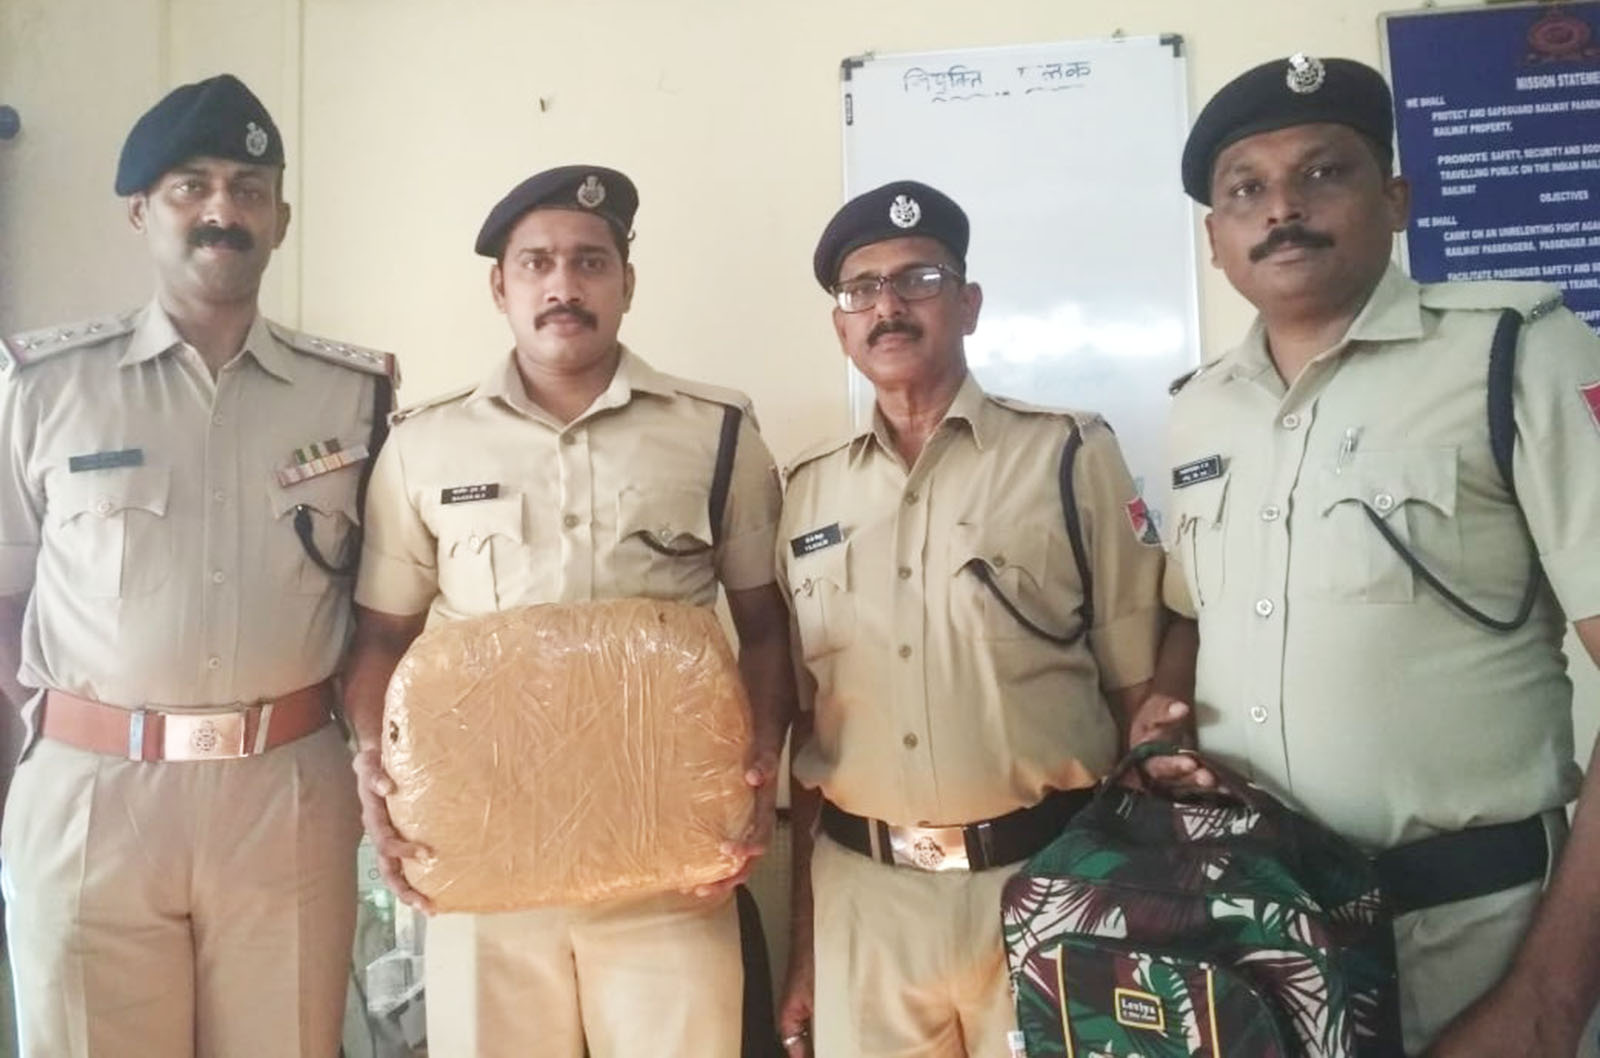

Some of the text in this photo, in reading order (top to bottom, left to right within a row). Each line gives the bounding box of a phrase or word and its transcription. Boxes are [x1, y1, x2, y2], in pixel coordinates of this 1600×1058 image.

[1516, 75, 1556, 90] MISSION
[1406, 97, 1445, 107] WE SHALL
[1432, 109, 1467, 121] PROTECT
[1469, 108, 1485, 118] AND
[1487, 105, 1533, 116] SAFEGUARD
[1535, 102, 1569, 113] RAILWAY
[1434, 125, 1468, 136] RAILWAY
[1438, 152, 1488, 165] PROMOTE
[1524, 147, 1562, 158] SECURITY
[1564, 145, 1580, 155] AND
[1440, 168, 1489, 180] TRAVELLING
[1490, 165, 1519, 176] PUBLIC
[1521, 165, 1533, 174] ON
[1534, 163, 1550, 172] THE
[1552, 161, 1579, 171] INDIAN
[1442, 185, 1476, 196] RAILWAY
[1540, 190, 1588, 202] OBJECTIVES
[1418, 216, 1457, 227] WE SHALL
[1444, 231, 1470, 241] CARRY
[1472, 230, 1484, 239] ON
[1486, 229, 1497, 238] AN
[1498, 224, 1555, 237] UNRELENTING
[1556, 222, 1580, 232] FIGHT
[1445, 246, 1480, 257] RAILWAY
[1539, 237, 1587, 249] PASSENGER
[1447, 270, 1492, 281] FACILITATE
[1493, 267, 1541, 278] PASSENGER
[1542, 265, 1572, 275] SAFETY
[1574, 264, 1590, 273] AND
